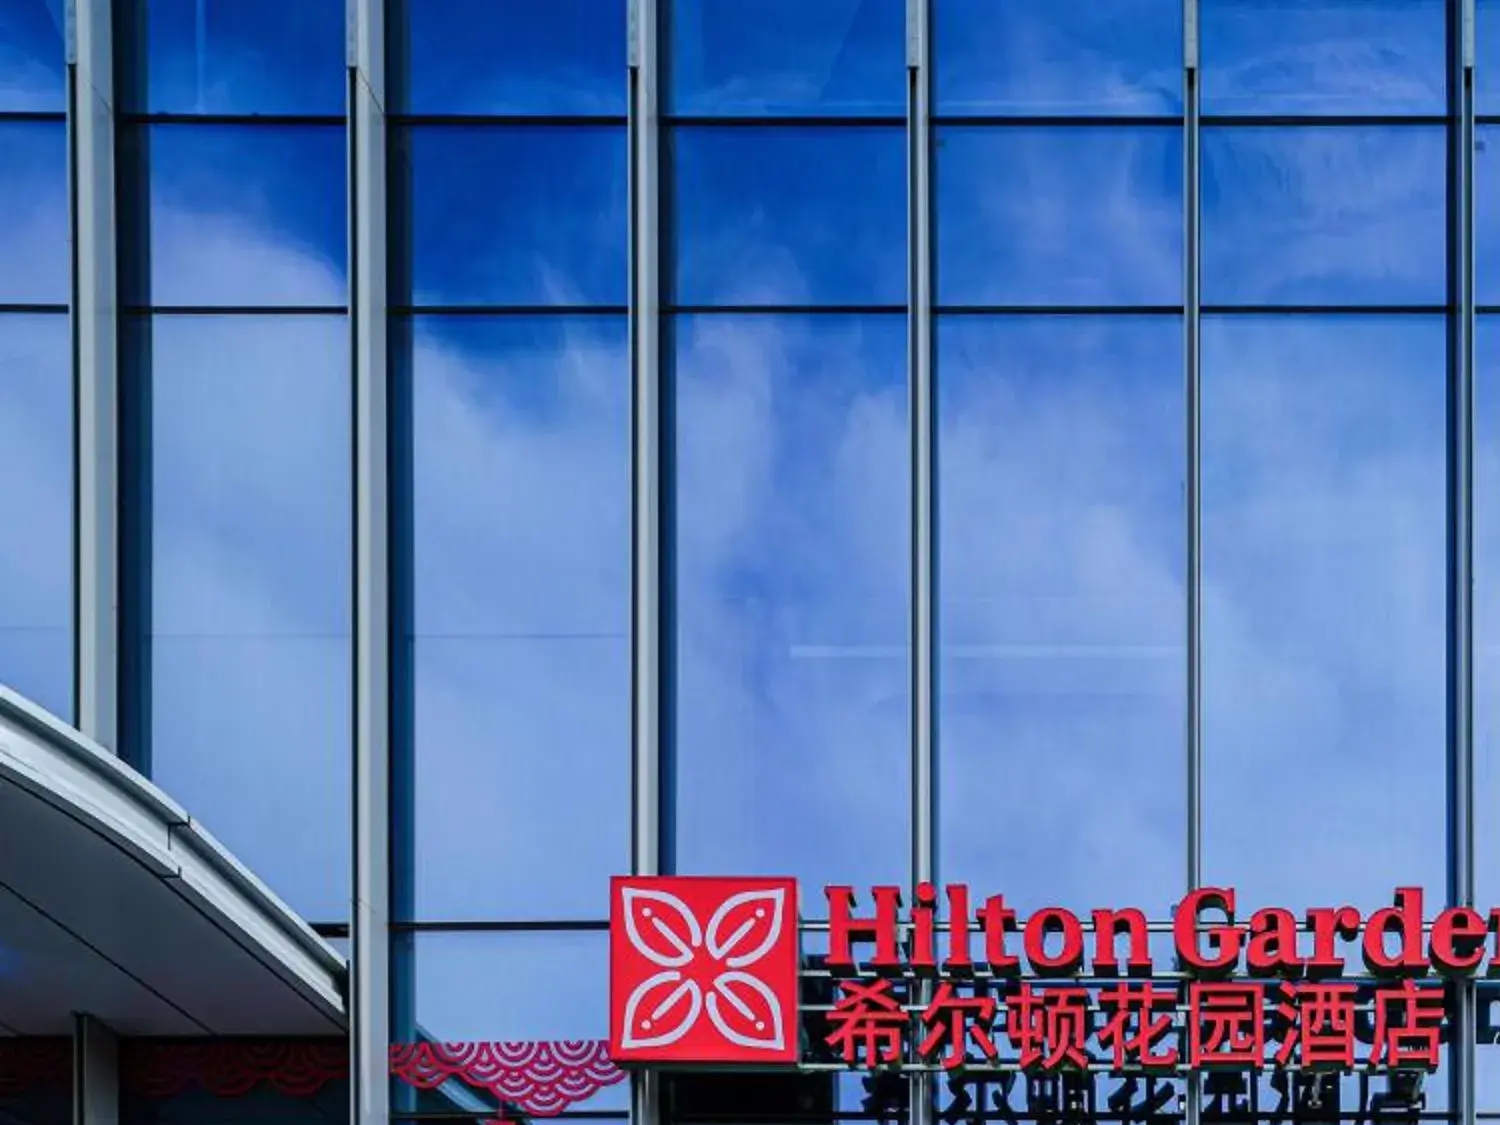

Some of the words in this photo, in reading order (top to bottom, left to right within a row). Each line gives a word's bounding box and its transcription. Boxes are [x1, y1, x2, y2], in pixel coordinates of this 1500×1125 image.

[824, 881, 1152, 972] Hilton
[824, 978, 1446, 1069] 希尔顿花园酒店
